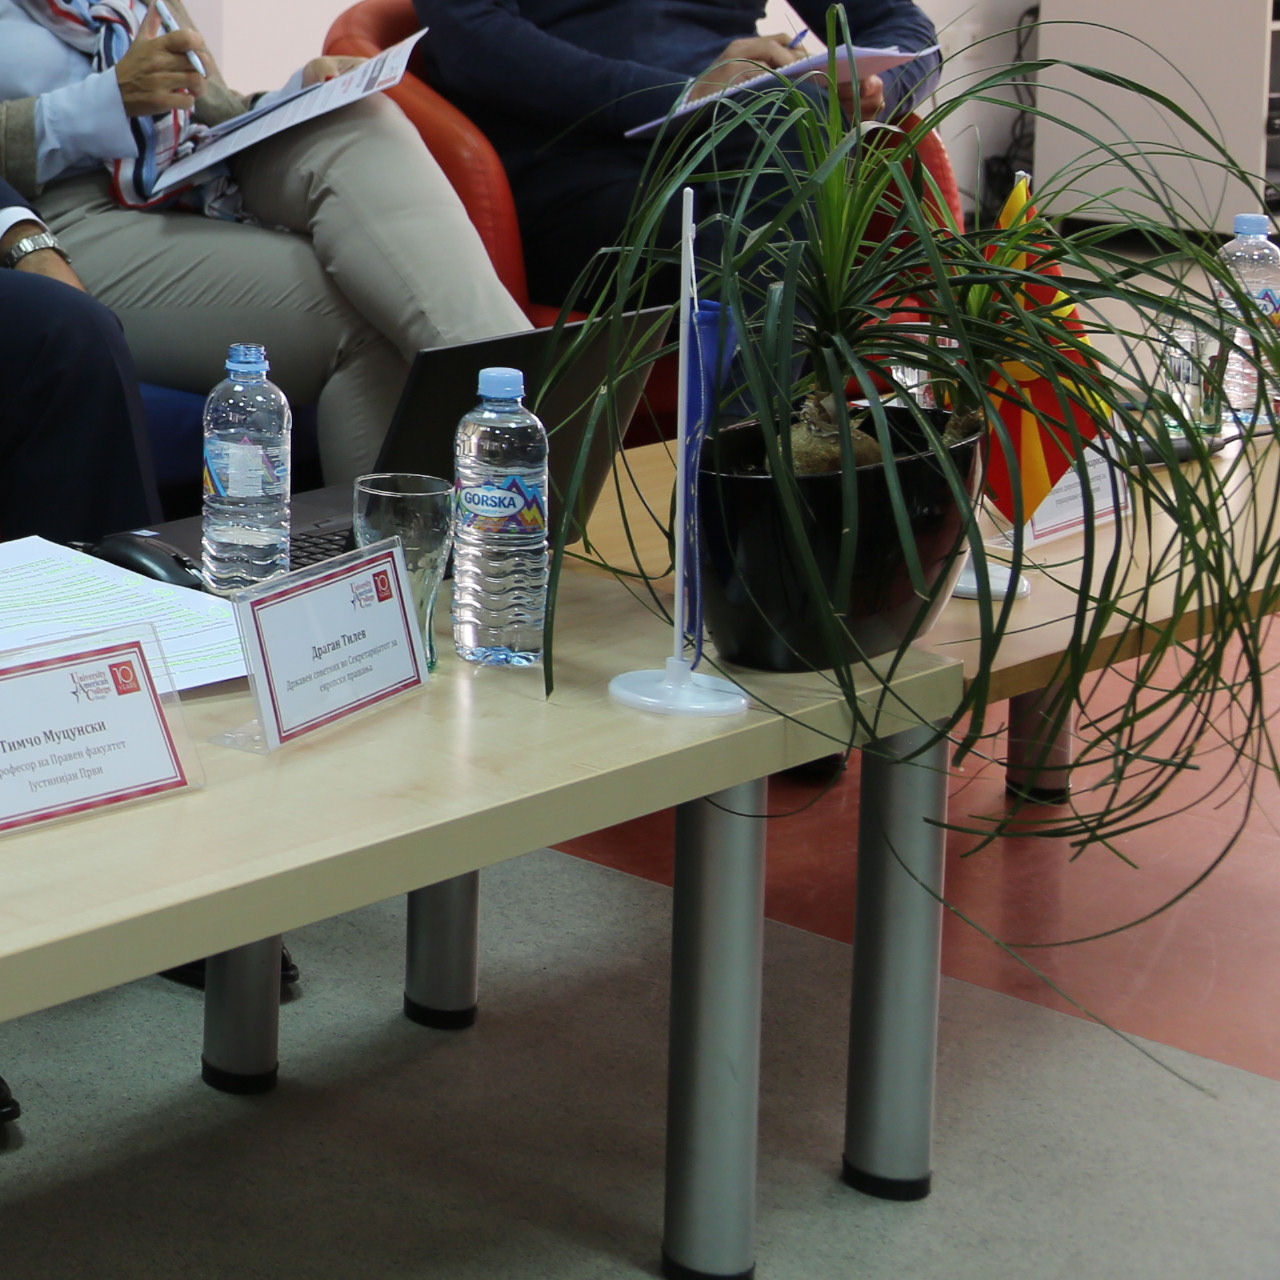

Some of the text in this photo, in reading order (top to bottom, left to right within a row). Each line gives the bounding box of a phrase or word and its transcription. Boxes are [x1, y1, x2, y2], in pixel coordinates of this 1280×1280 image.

[465, 492, 517, 508] GORSKA
[311, 630, 366, 661] Драган Тилев
[112, 666, 133, 684] 10
[42, 721, 107, 745] Муцунски
[38, 758, 50, 768] на
[50, 750, 84, 766] Правен
[85, 741, 126, 759] факултет
[79, 766, 104, 781] Први
